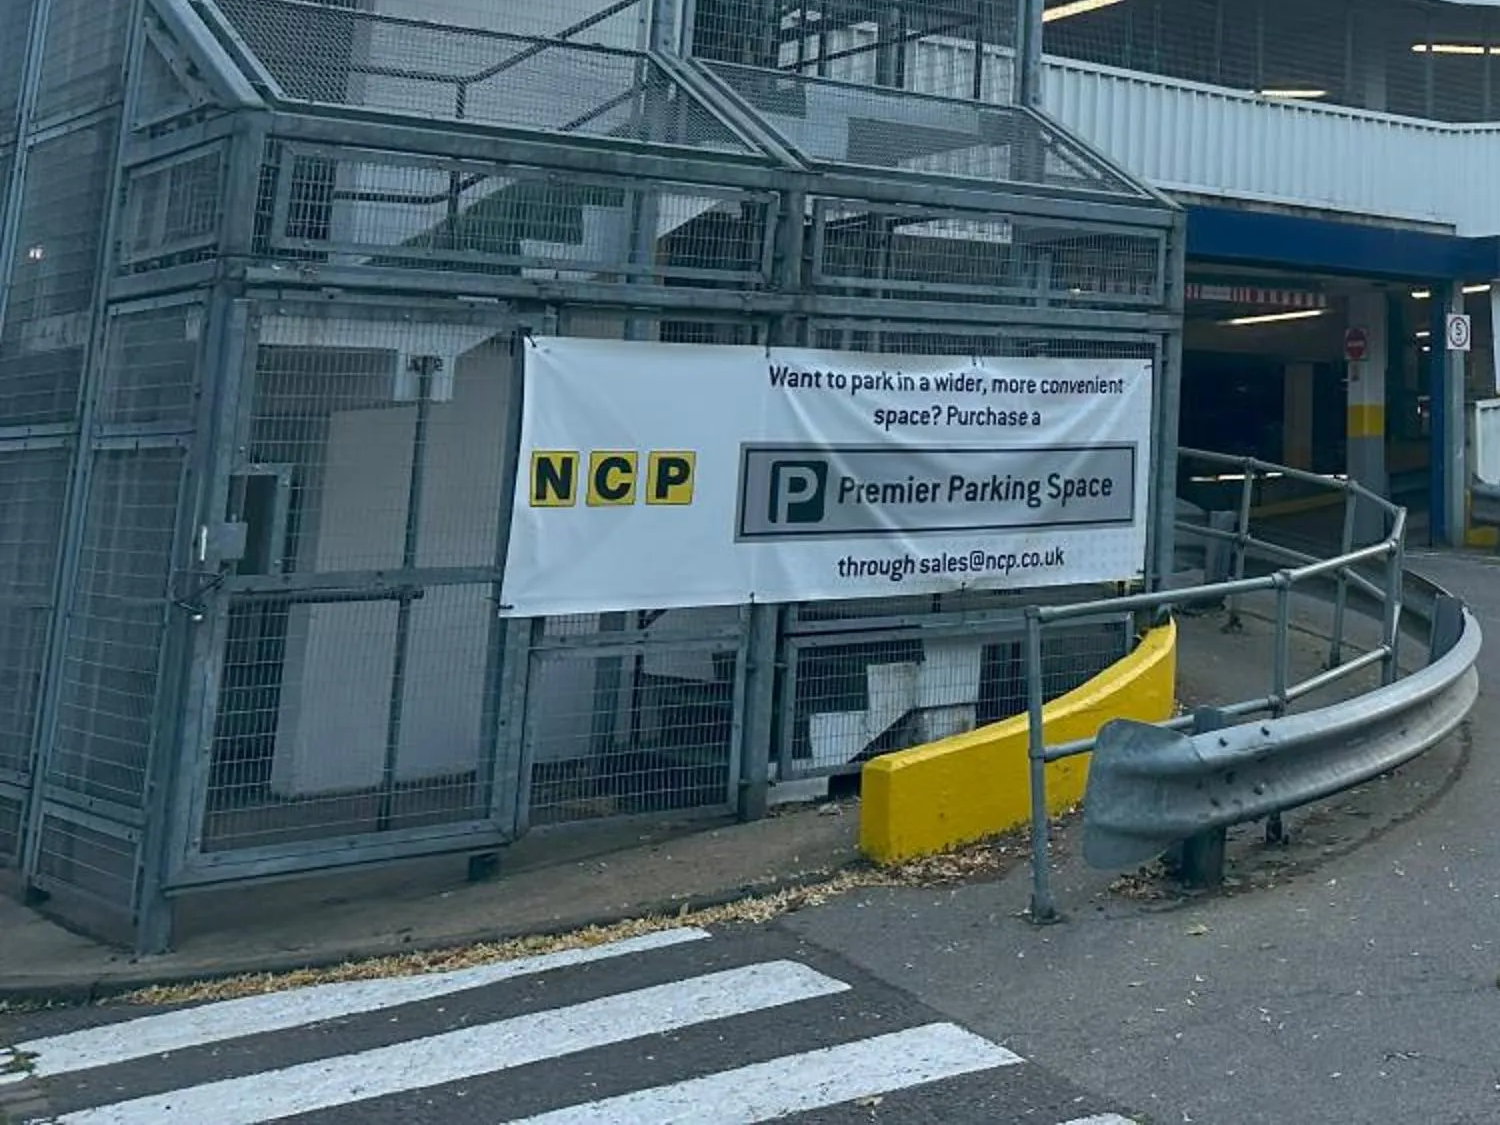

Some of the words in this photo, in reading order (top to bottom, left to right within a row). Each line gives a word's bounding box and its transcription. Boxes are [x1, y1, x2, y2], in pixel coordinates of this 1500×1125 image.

[769, 365, 821, 389] Want
[827, 371, 847, 390] to
[851, 371, 894, 396] park
[897, 372, 915, 391] in
[919, 377, 930, 392] a
[934, 373, 987, 396] wider,
[992, 378, 1036, 394] more
[1040, 377, 1123, 394] convenient
[874, 406, 941, 432] space?
[946, 406, 1027, 426] Purchase
[1031, 411, 1041, 426] a
[535, 456, 691, 501] NCP
[837, 475, 941, 505] Premier
[947, 474, 1041, 509] Parking
[1047, 472, 1113, 508] Space
[837, 553, 915, 582] through
[919, 546, 1065, 576] sales@ncp.co.uk
